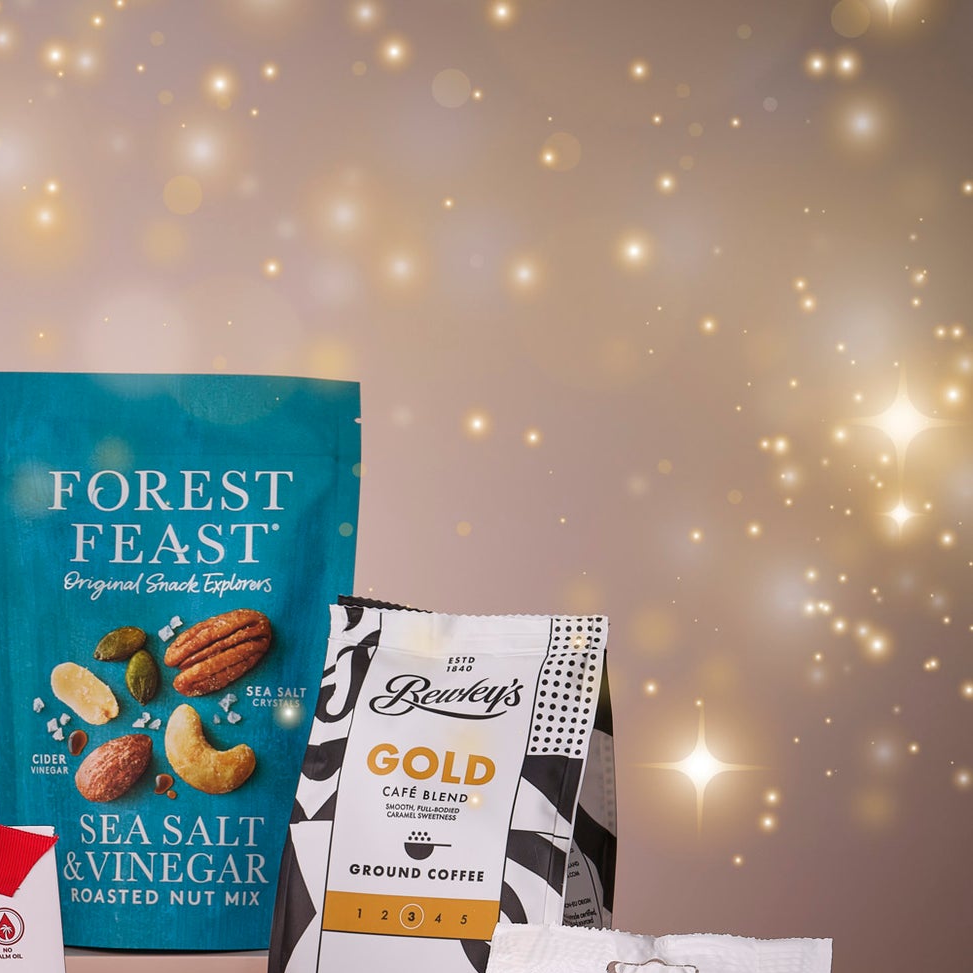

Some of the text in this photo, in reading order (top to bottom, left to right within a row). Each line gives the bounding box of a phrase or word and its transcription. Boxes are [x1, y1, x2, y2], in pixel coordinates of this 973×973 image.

[48, 470, 294, 512] FOREST
[64, 571, 273, 601] Original Snack Explorers
[448, 657, 476, 665] ESTD
[246, 686, 307, 698] SEA SALT
[369, 674, 524, 720] Bewley's
[252, 698, 300, 707] CRYSTALS
[32, 754, 67, 765] CIDER
[366, 743, 496, 786] GOLD
[30, 766, 69, 775] VINEGAR
[382, 786, 468, 803] CAFÉ BLEND
[386, 811, 457, 821] CARAMEL SWEETNESS
[80, 813, 265, 847] SEA SALT
[349, 863, 484, 882] GROUND COFFEE
[71, 887, 260, 906] ROASTED NUT MIX
[356, 908, 468, 925] 1 2 3 4 5
